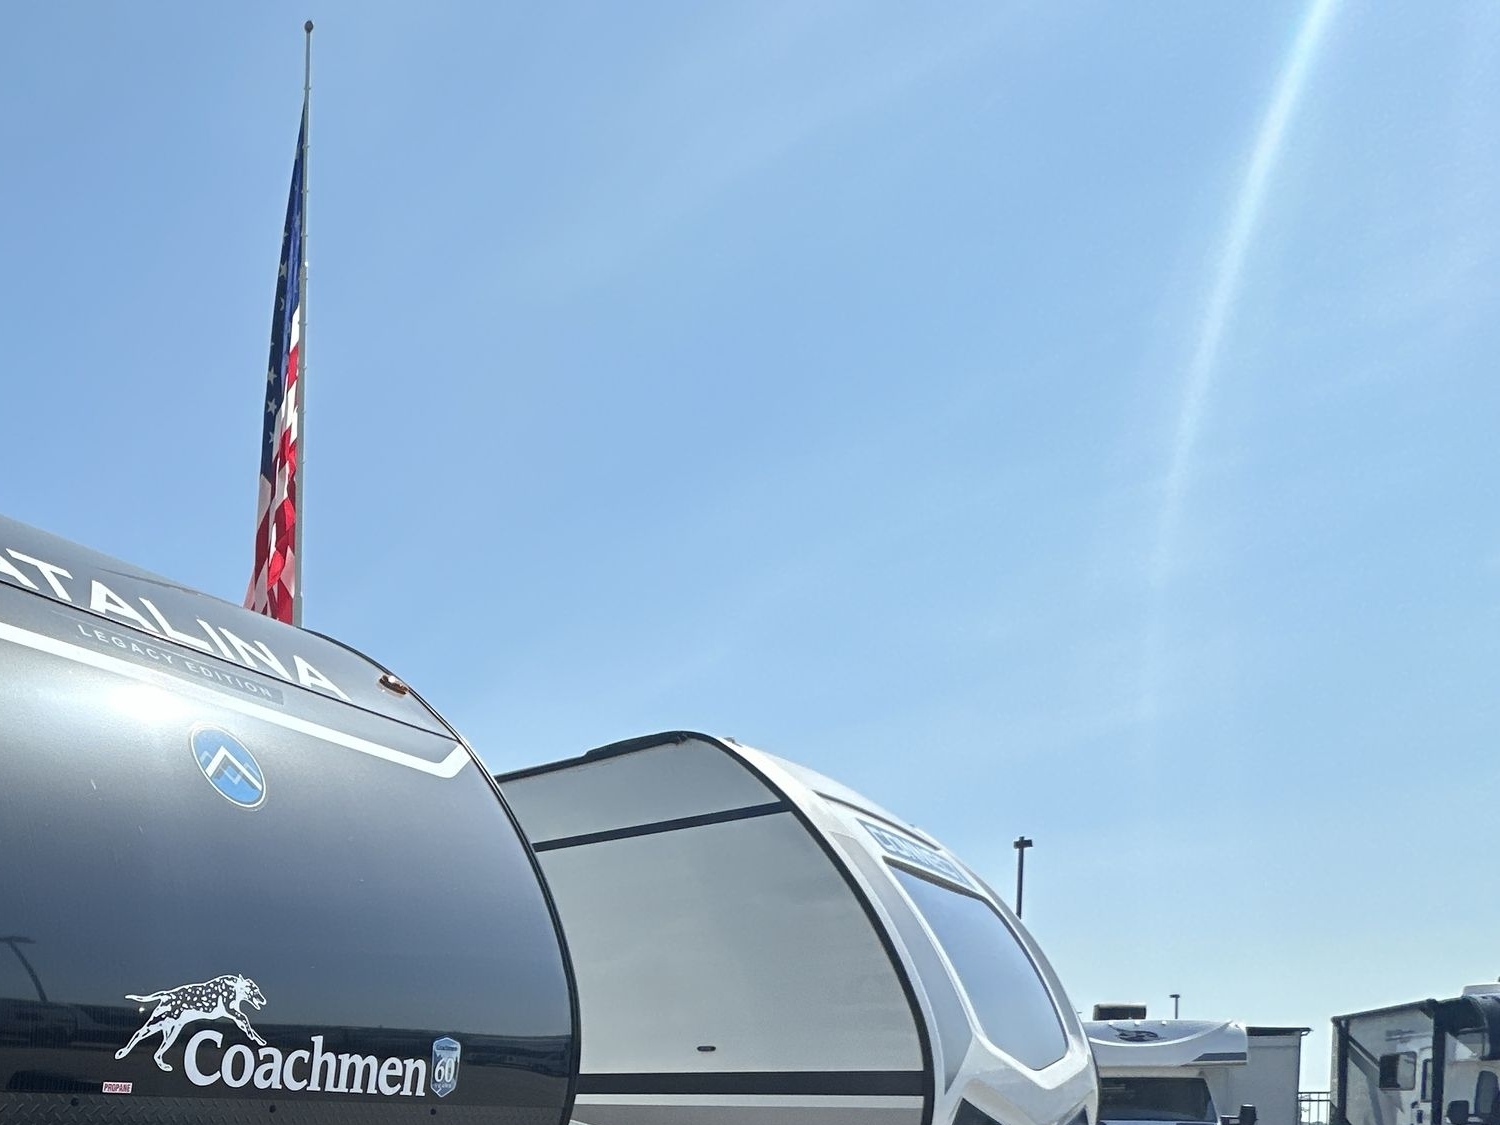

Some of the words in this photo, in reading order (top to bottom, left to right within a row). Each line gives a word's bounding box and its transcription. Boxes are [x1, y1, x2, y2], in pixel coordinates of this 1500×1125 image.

[77, 624, 174, 665] LEGACY
[185, 661, 273, 698] EDITION
[183, 1029, 427, 1097] Coachmen
[434, 1057, 455, 1083] 60
[103, 1083, 131, 1092] PROPANE
